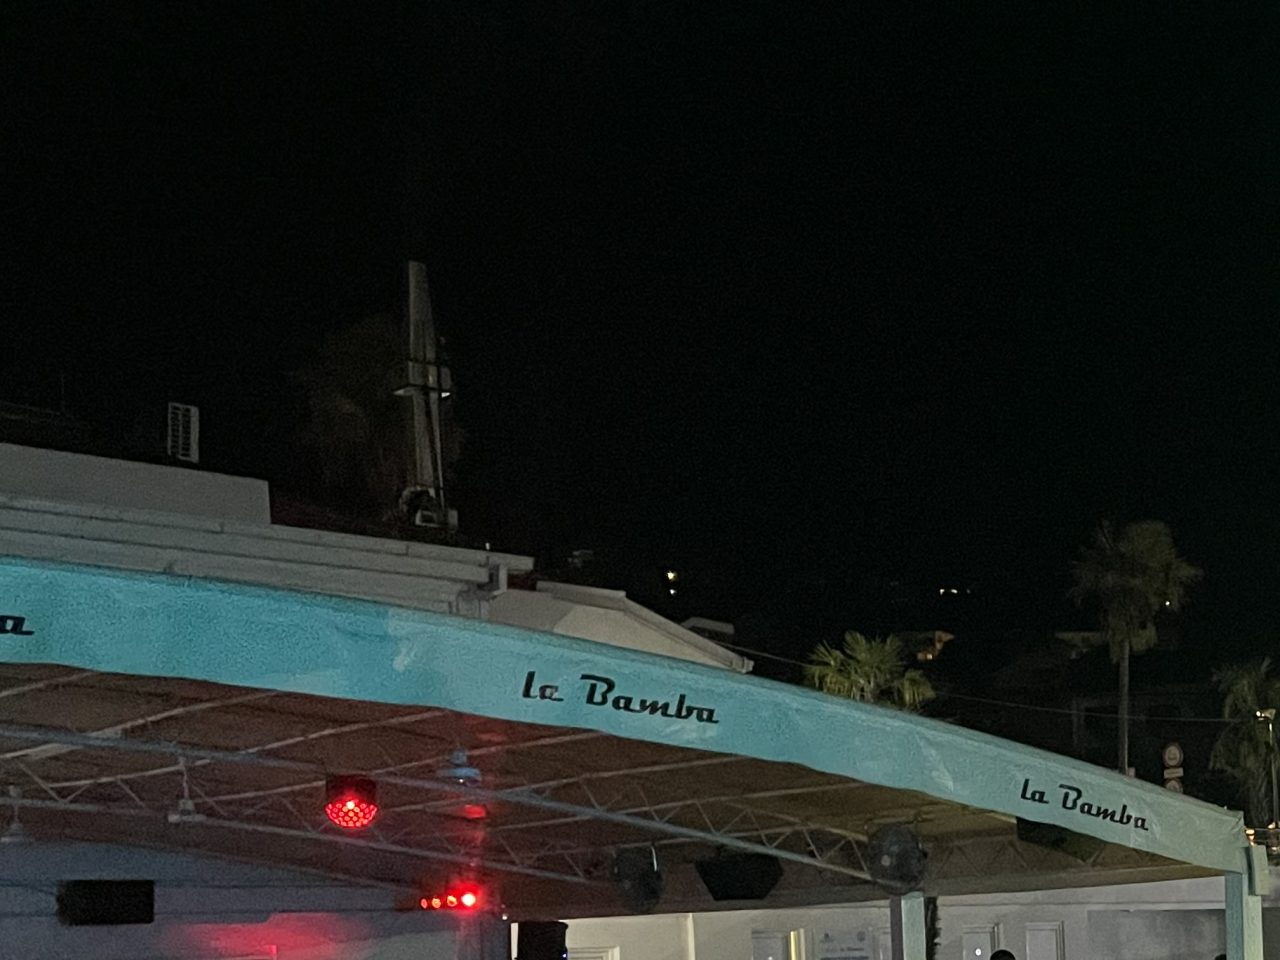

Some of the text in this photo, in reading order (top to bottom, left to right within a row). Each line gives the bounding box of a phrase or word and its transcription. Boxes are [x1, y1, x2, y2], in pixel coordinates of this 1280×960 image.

[522, 671, 719, 724] La Bamba
[1021, 778, 1149, 831] La Bamba
